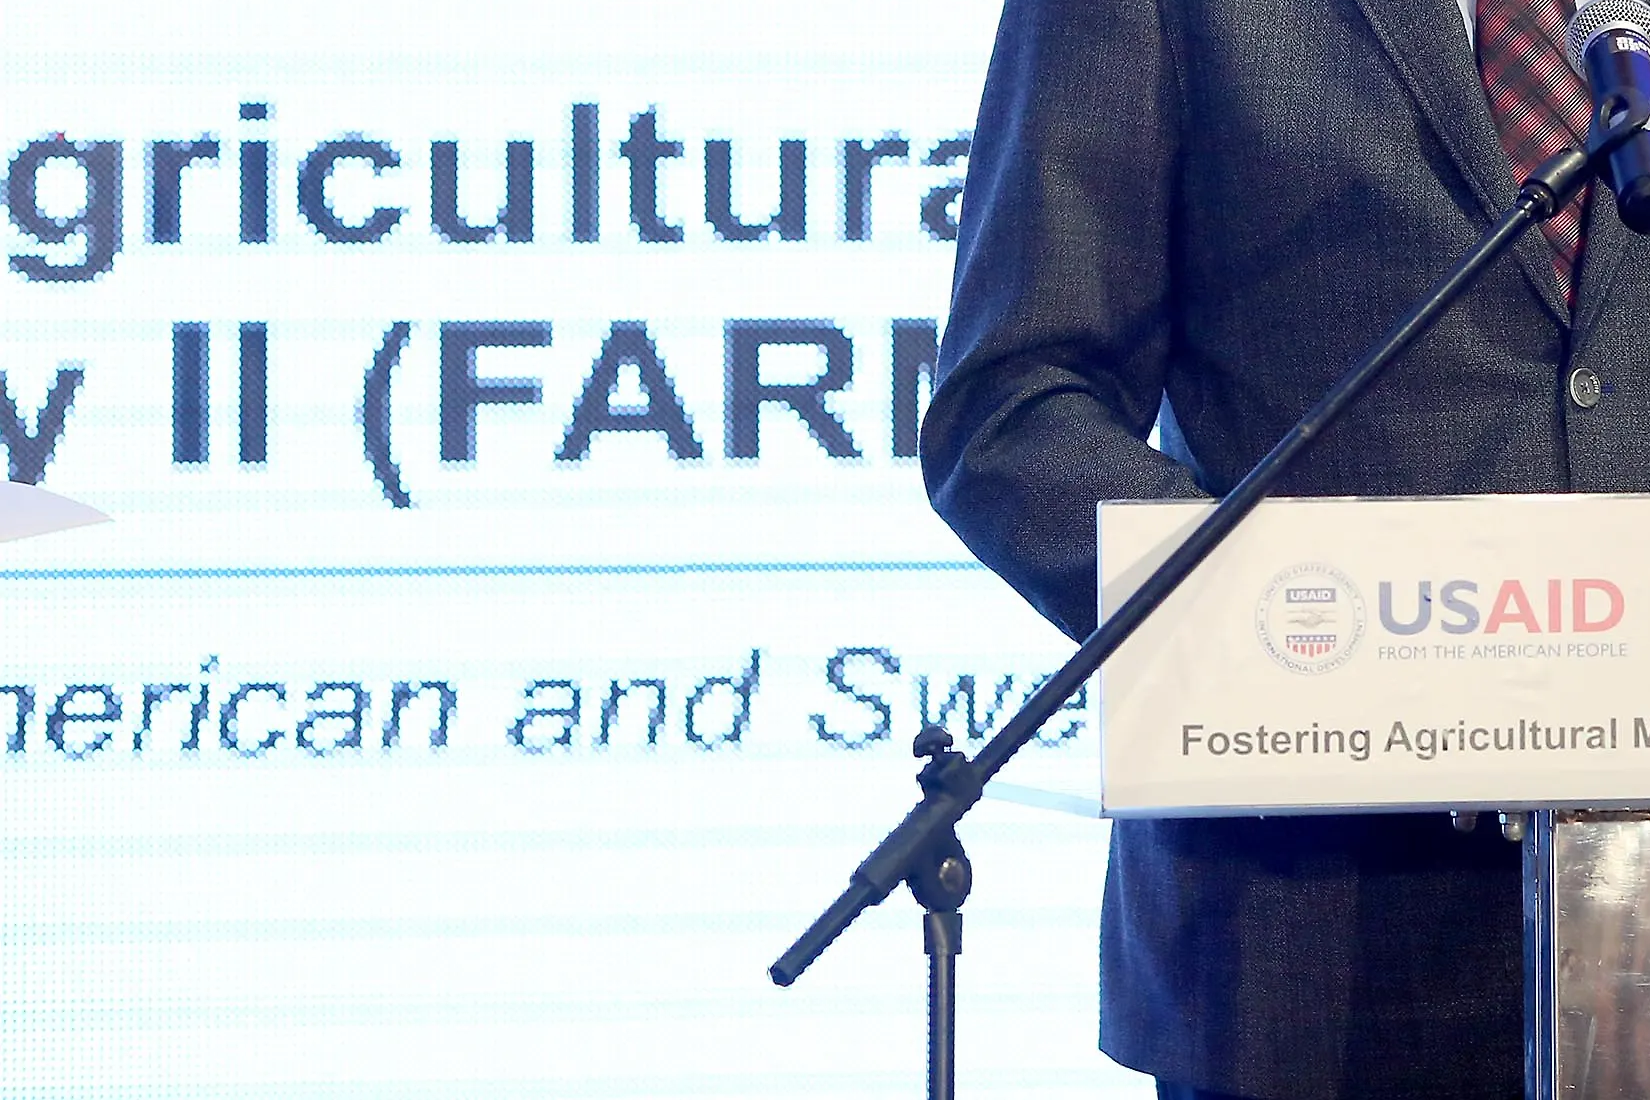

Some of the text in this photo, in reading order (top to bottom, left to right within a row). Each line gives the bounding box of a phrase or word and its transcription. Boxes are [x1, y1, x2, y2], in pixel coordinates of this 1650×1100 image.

[171, 320, 268, 468] II
[1290, 589, 1331, 601] USAID
[1379, 579, 1625, 635] USAID
[1379, 643, 1627, 660] FROM THE AMERICAN PEOPLE
[506, 647, 761, 761] and
[1181, 722, 1371, 761] Fostering
[1384, 718, 1617, 761] Agricultural
